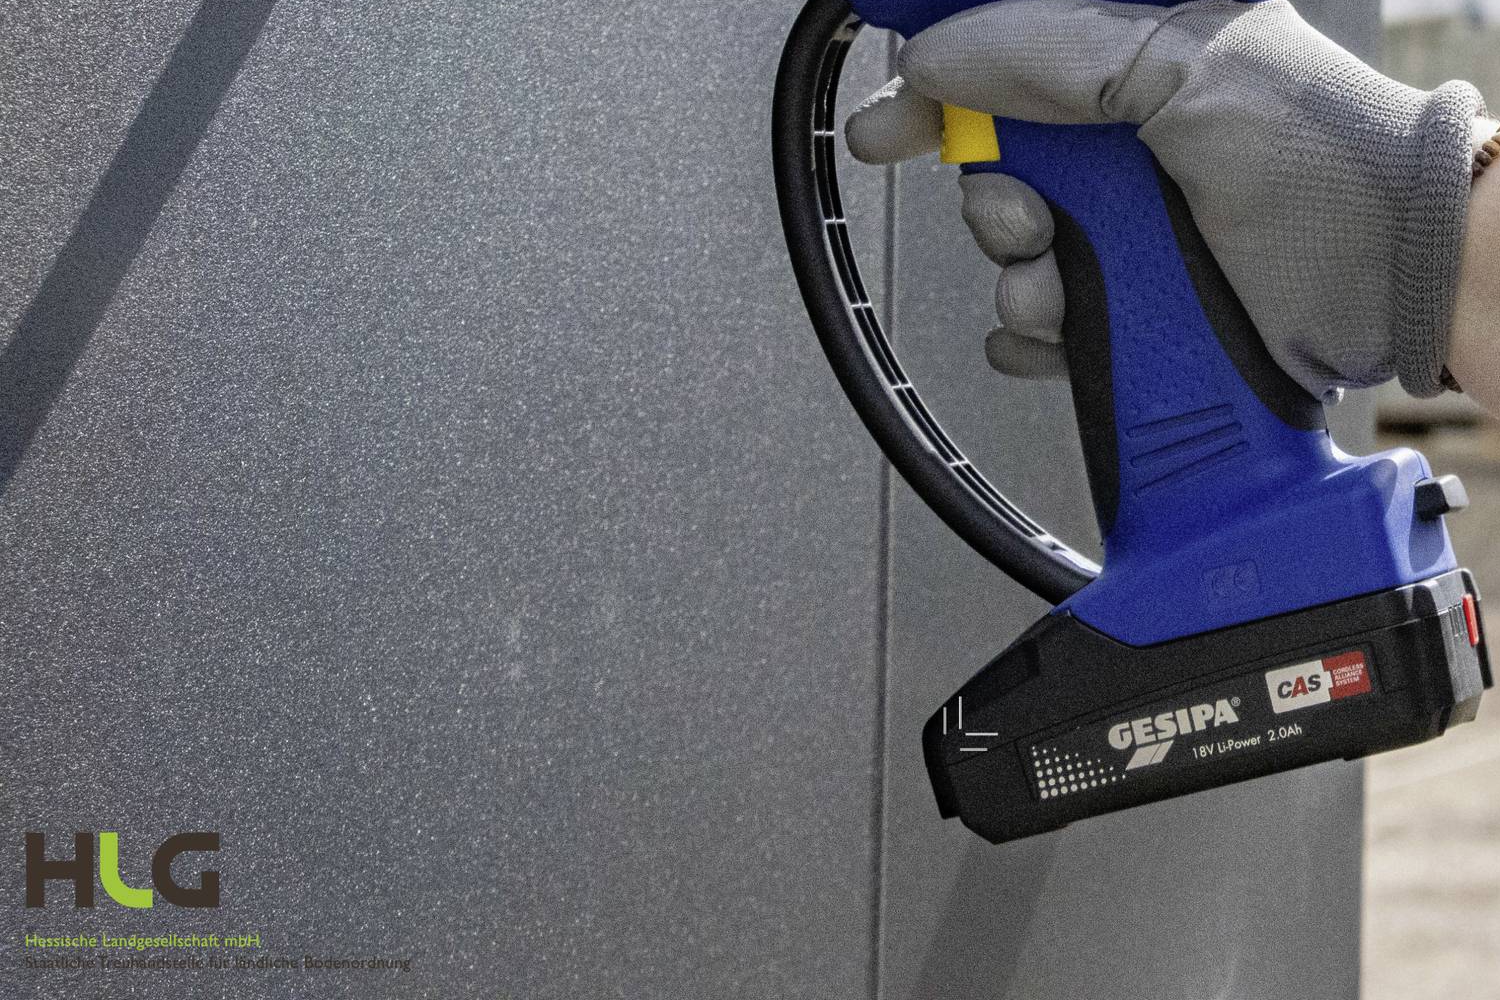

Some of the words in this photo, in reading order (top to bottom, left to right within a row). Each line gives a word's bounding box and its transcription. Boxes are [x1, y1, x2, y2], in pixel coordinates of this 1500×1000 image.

[1332, 663, 1364, 676] CORDLESS
[1333, 669, 1363, 681] ALLIANCE
[1277, 674, 1322, 699] CAS
[1335, 675, 1361, 687] SYSTEM
[1192, 743, 1214, 760] 18V
[1216, 735, 1262, 754] Li-Power
[1267, 723, 1303, 743] 2.0Ah
